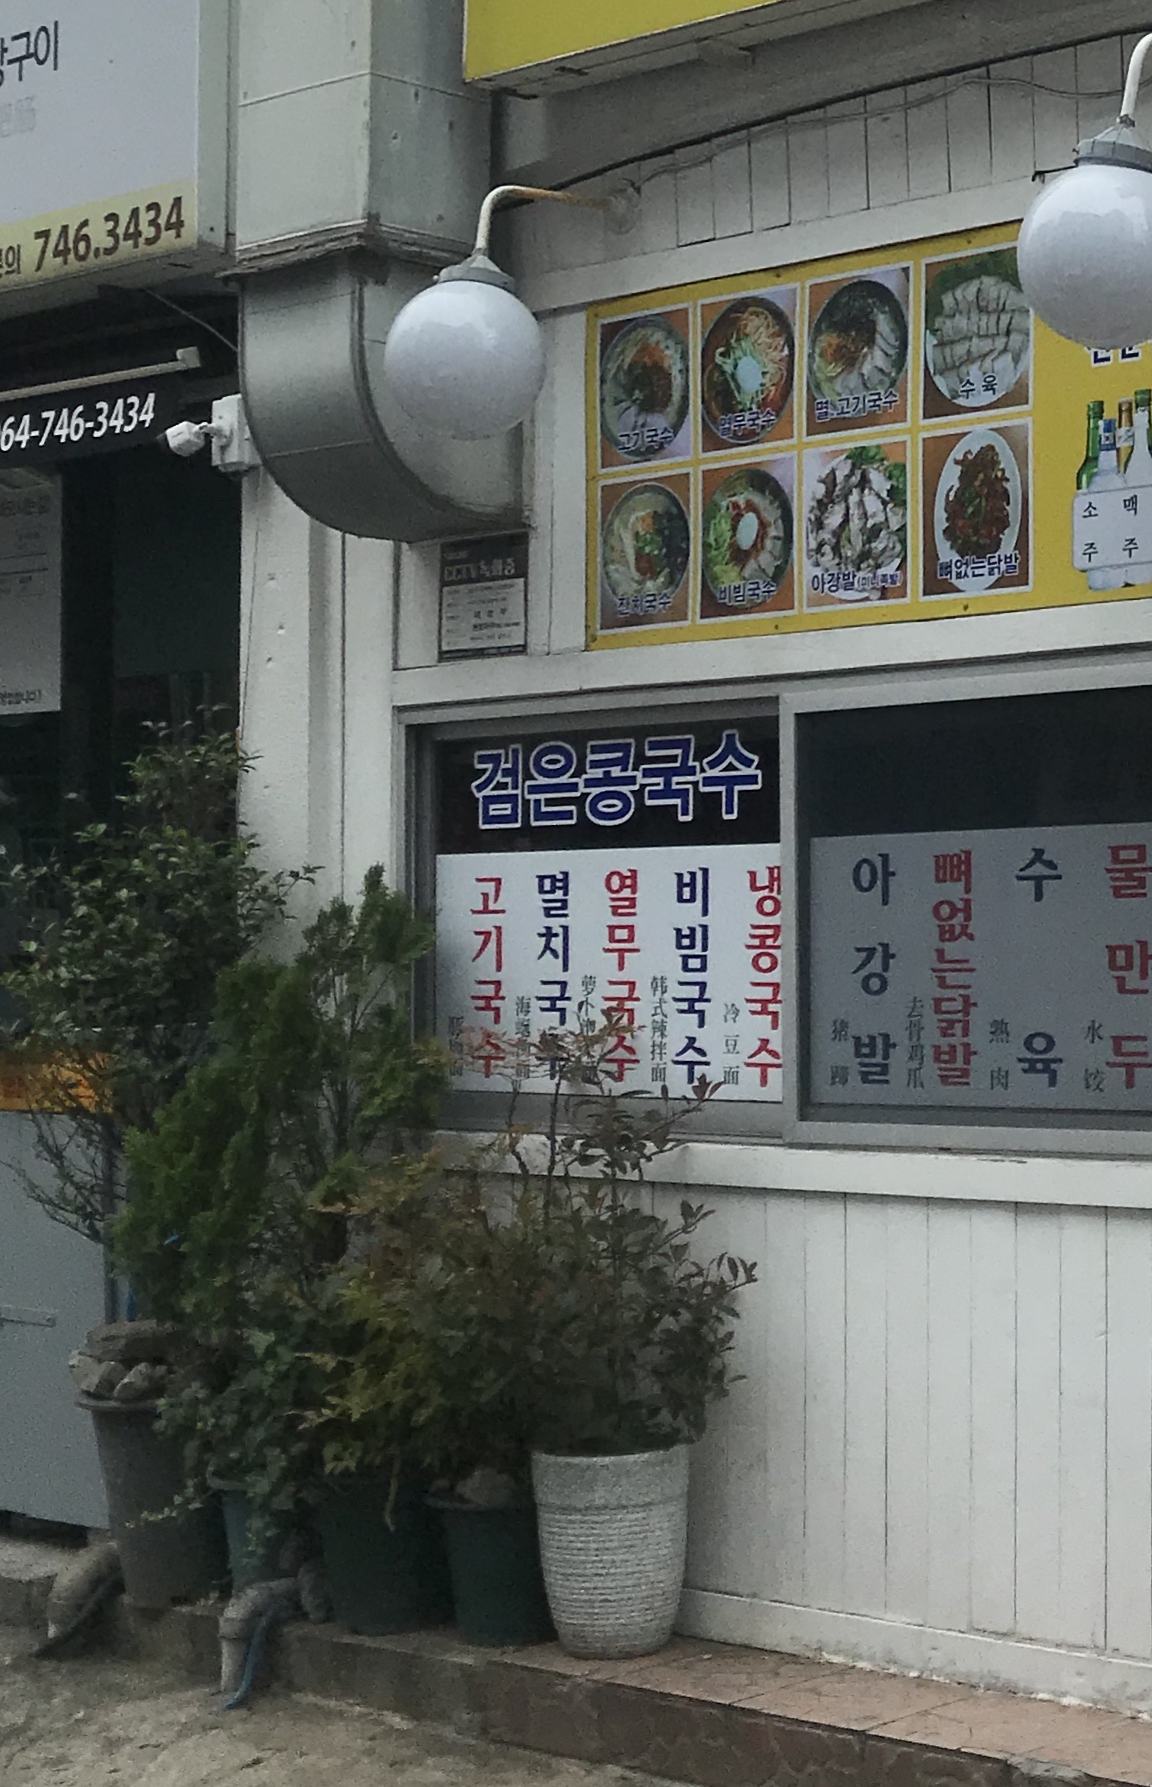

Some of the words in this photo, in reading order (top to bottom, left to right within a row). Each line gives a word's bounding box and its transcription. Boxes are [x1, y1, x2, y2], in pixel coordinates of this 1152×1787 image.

[34, 195, 186, 273] 746.3434
[618, 425, 675, 453] 고기국수
[718, 580, 777, 605] 비빔국수
[937, 551, 1020, 581] 뼈없는닭발
[1082, 500, 1099, 563] 소주
[1121, 494, 1139, 559] 맥주
[471, 729, 762, 830] 검은콩국수
[470, 877, 507, 1080] 고기국수
[602, 869, 642, 1083] 열무국수
[672, 867, 712, 1085] 비빔국수
[744, 865, 783, 1088] 냉콩국수
[851, 852, 897, 1086] 아강발
[930, 849, 979, 1088] 뼈없는닭발
[1015, 847, 1063, 1089] 수육
